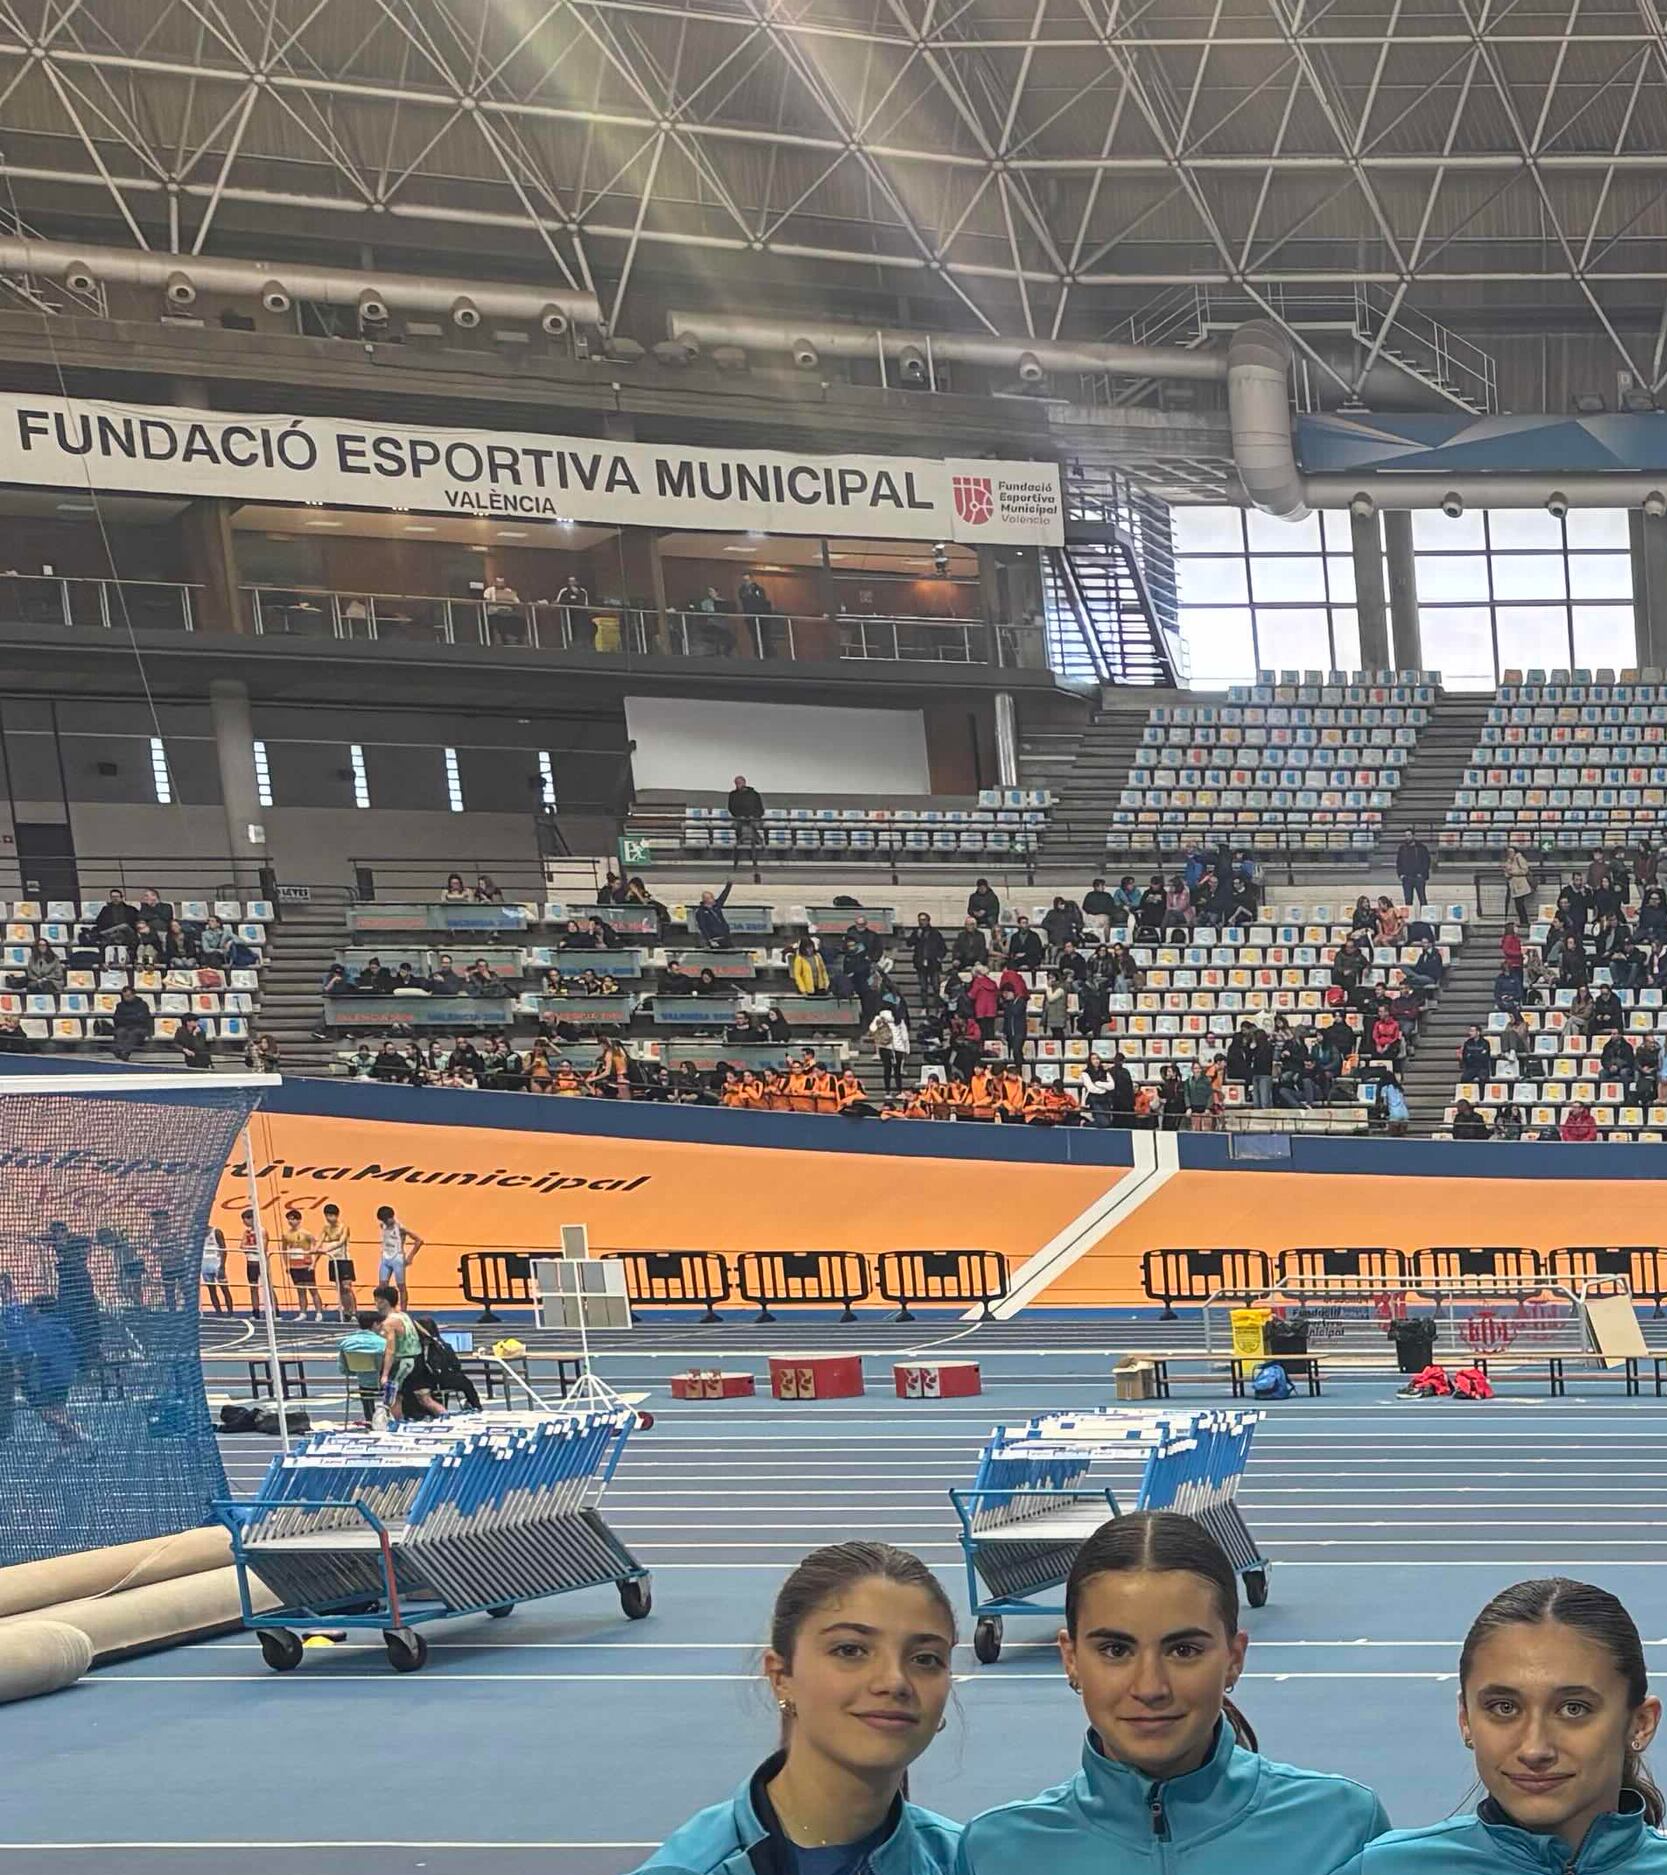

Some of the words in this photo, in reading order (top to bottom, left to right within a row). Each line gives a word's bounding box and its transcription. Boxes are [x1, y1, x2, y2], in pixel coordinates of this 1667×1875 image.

[17, 409, 318, 471] FUNDACIÓ
[336, 434, 640, 494] ESPORTIVA
[656, 459, 934, 510] MUNICIPAL
[999, 480, 1052, 494] Fundació
[444, 490, 558, 517] VALÈNCIA
[999, 492, 1056, 505] Esportiva
[1000, 504, 1058, 516] Municipal
